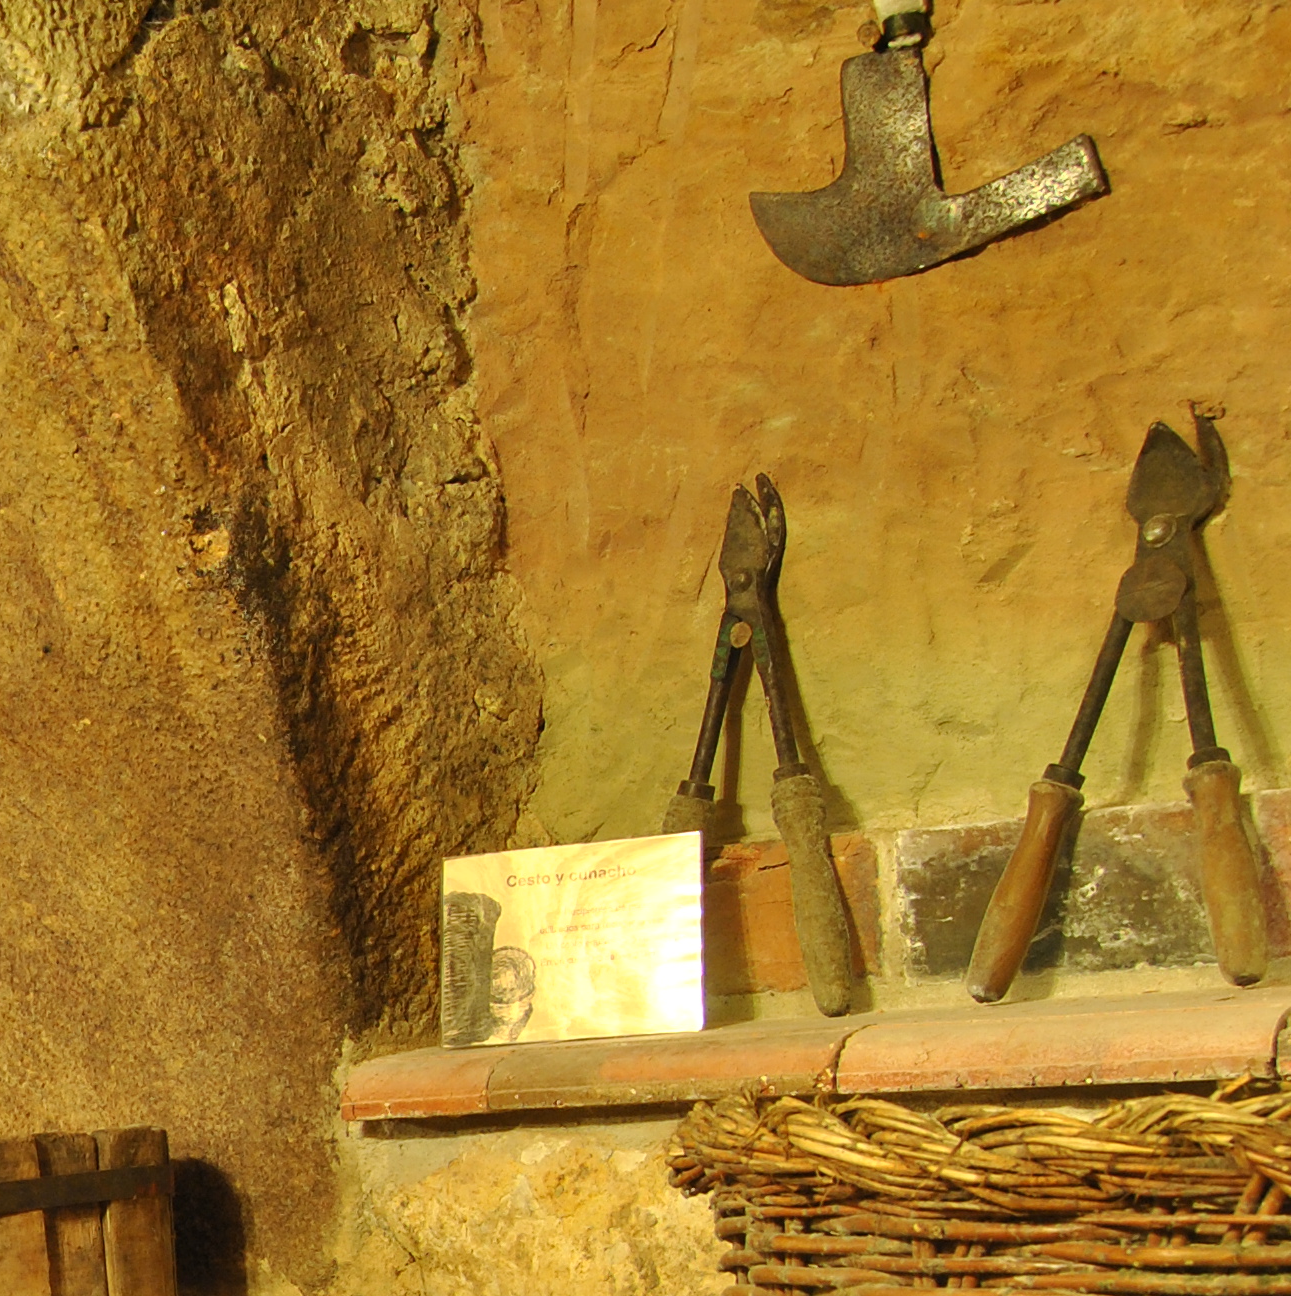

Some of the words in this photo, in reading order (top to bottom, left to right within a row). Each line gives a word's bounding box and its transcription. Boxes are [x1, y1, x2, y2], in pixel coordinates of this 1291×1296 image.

[506, 873, 551, 888] Cesto
[555, 873, 564, 887] y
[568, 864, 637, 881] cunacho
